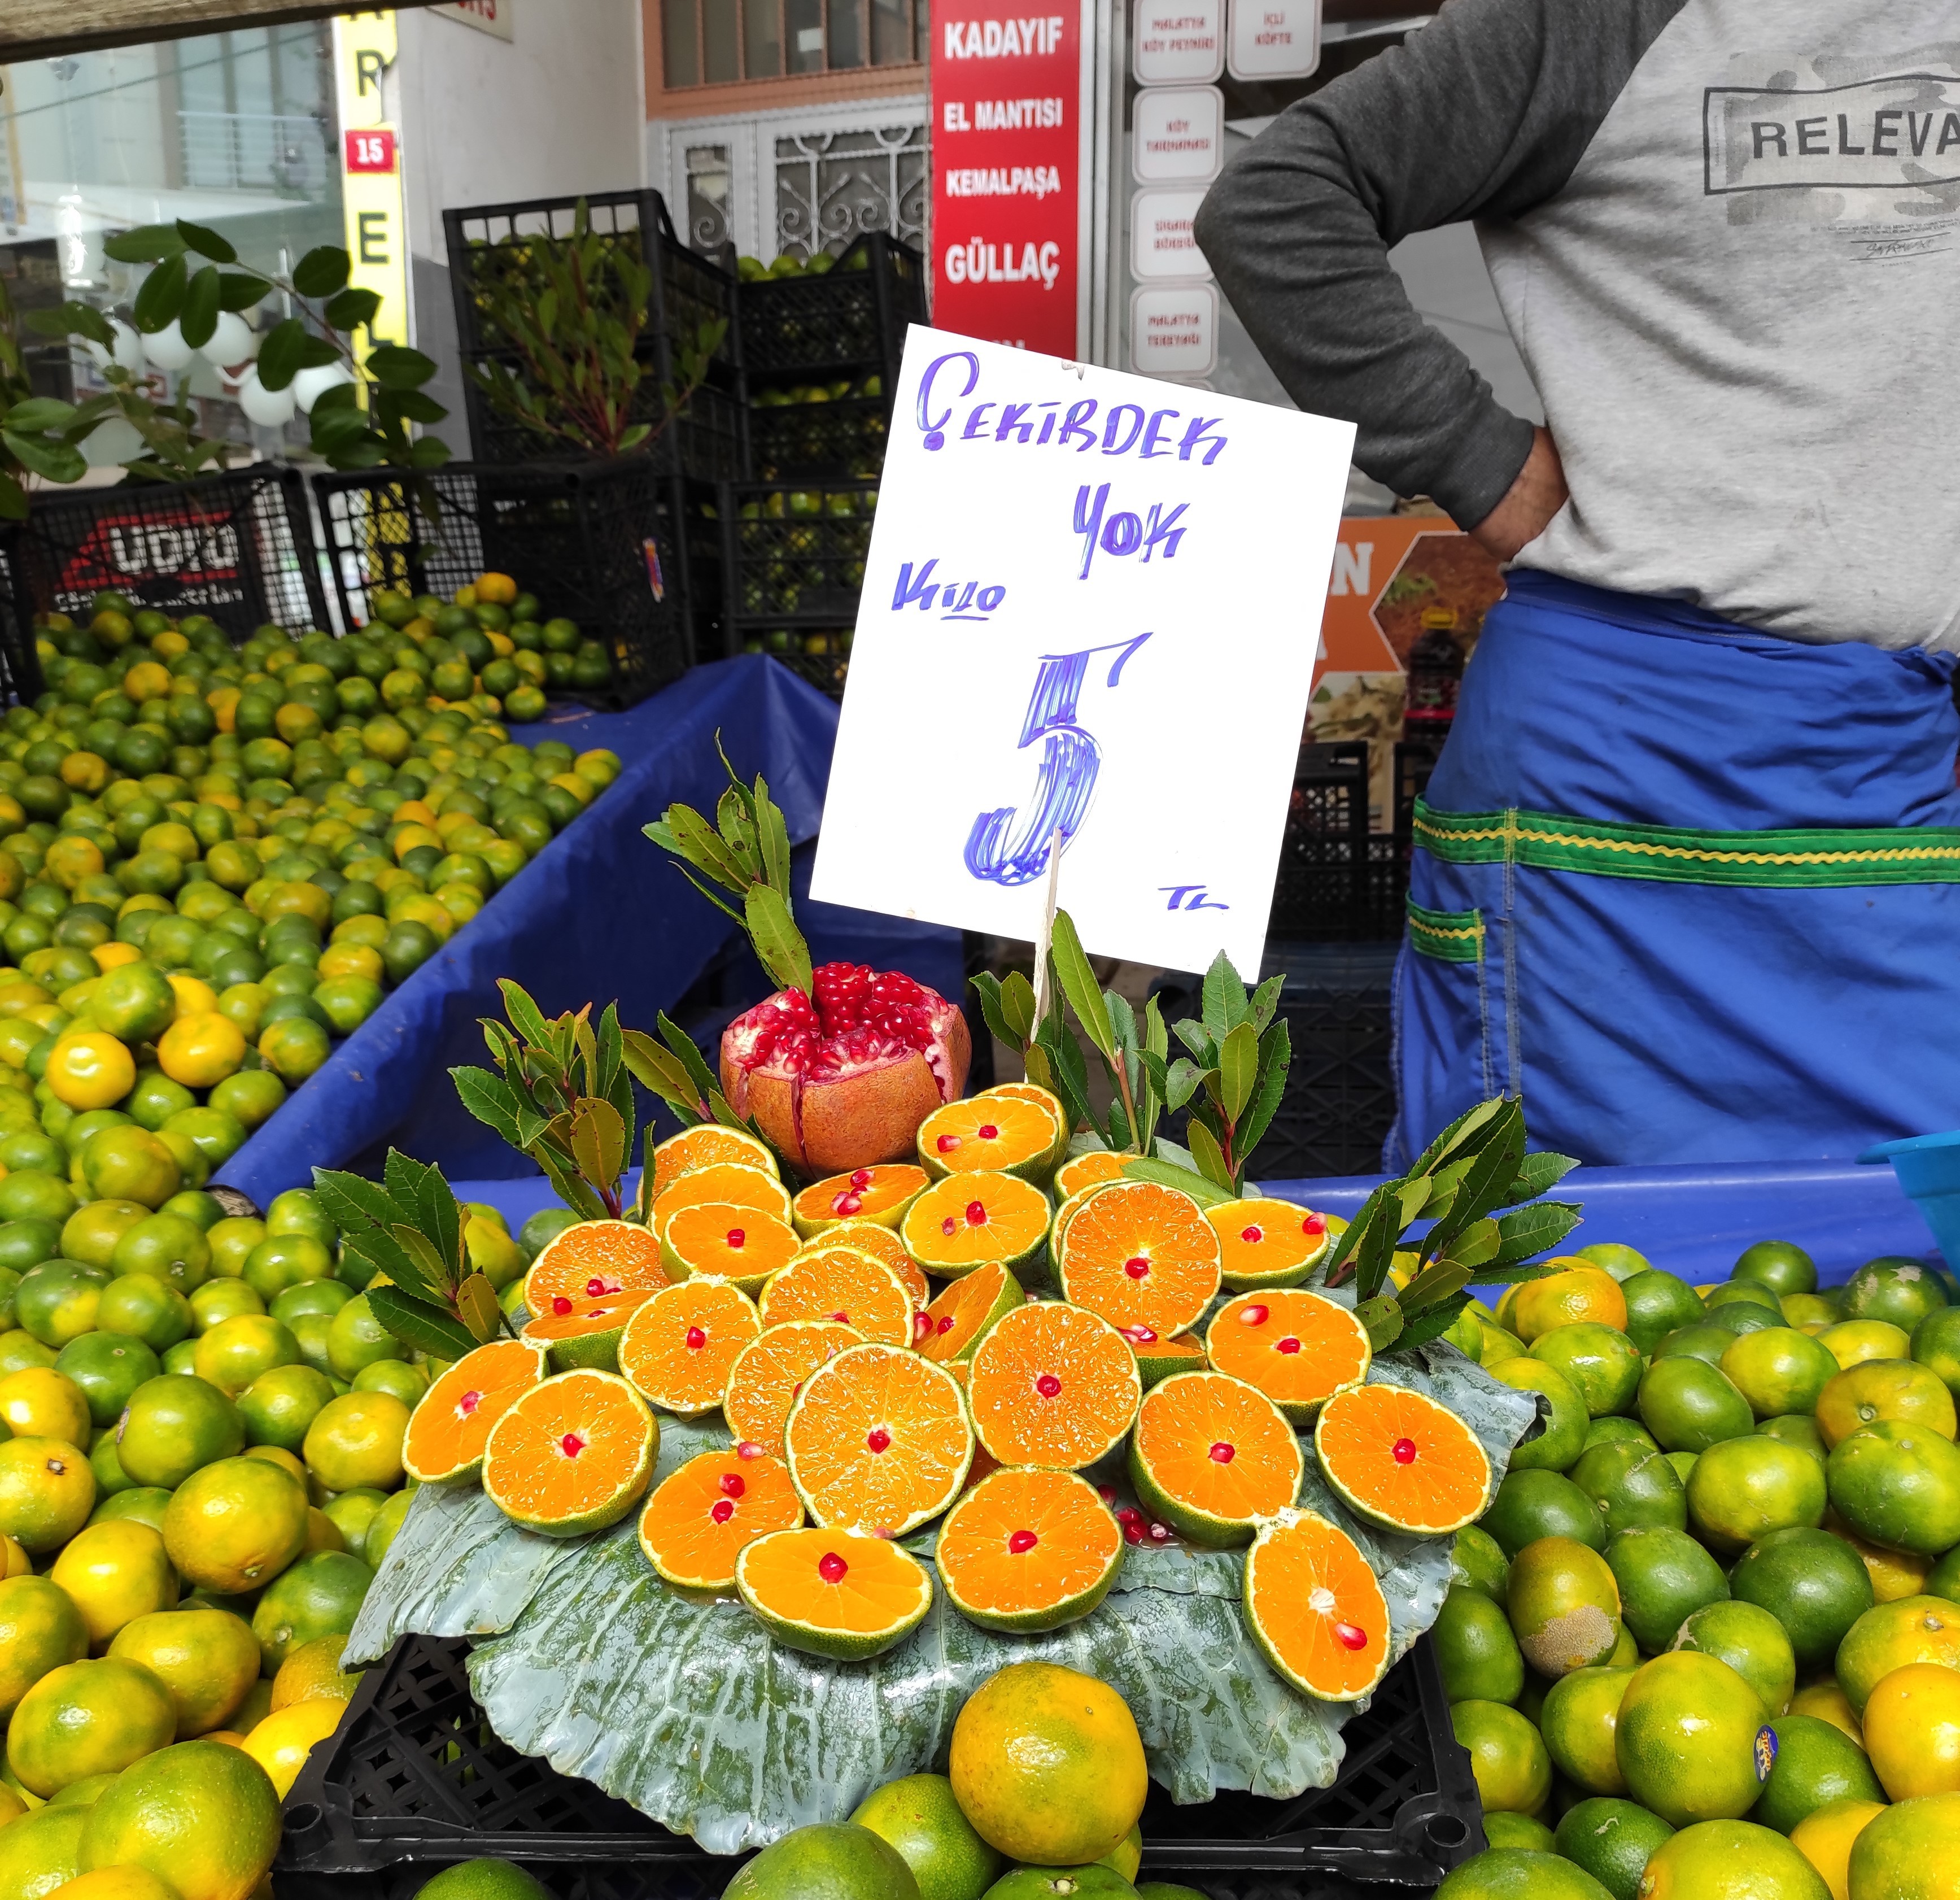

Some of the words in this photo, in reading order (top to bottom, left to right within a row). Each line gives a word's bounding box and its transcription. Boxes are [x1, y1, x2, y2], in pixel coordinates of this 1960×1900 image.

[945, 17, 1064, 59] KADAYIF
[944, 102, 970, 132] EL
[975, 98, 1063, 130] MANTISI
[356, 138, 384, 164] 15
[946, 166, 1061, 199] KEMALPAŞA
[945, 236, 1060, 290] GÜLLAÇ
[918, 352, 1228, 465] ÇEKİRDEK
[1073, 482, 1190, 580] YOK
[963, 631, 1154, 886] 5
[1158, 884, 1230, 910] TL
